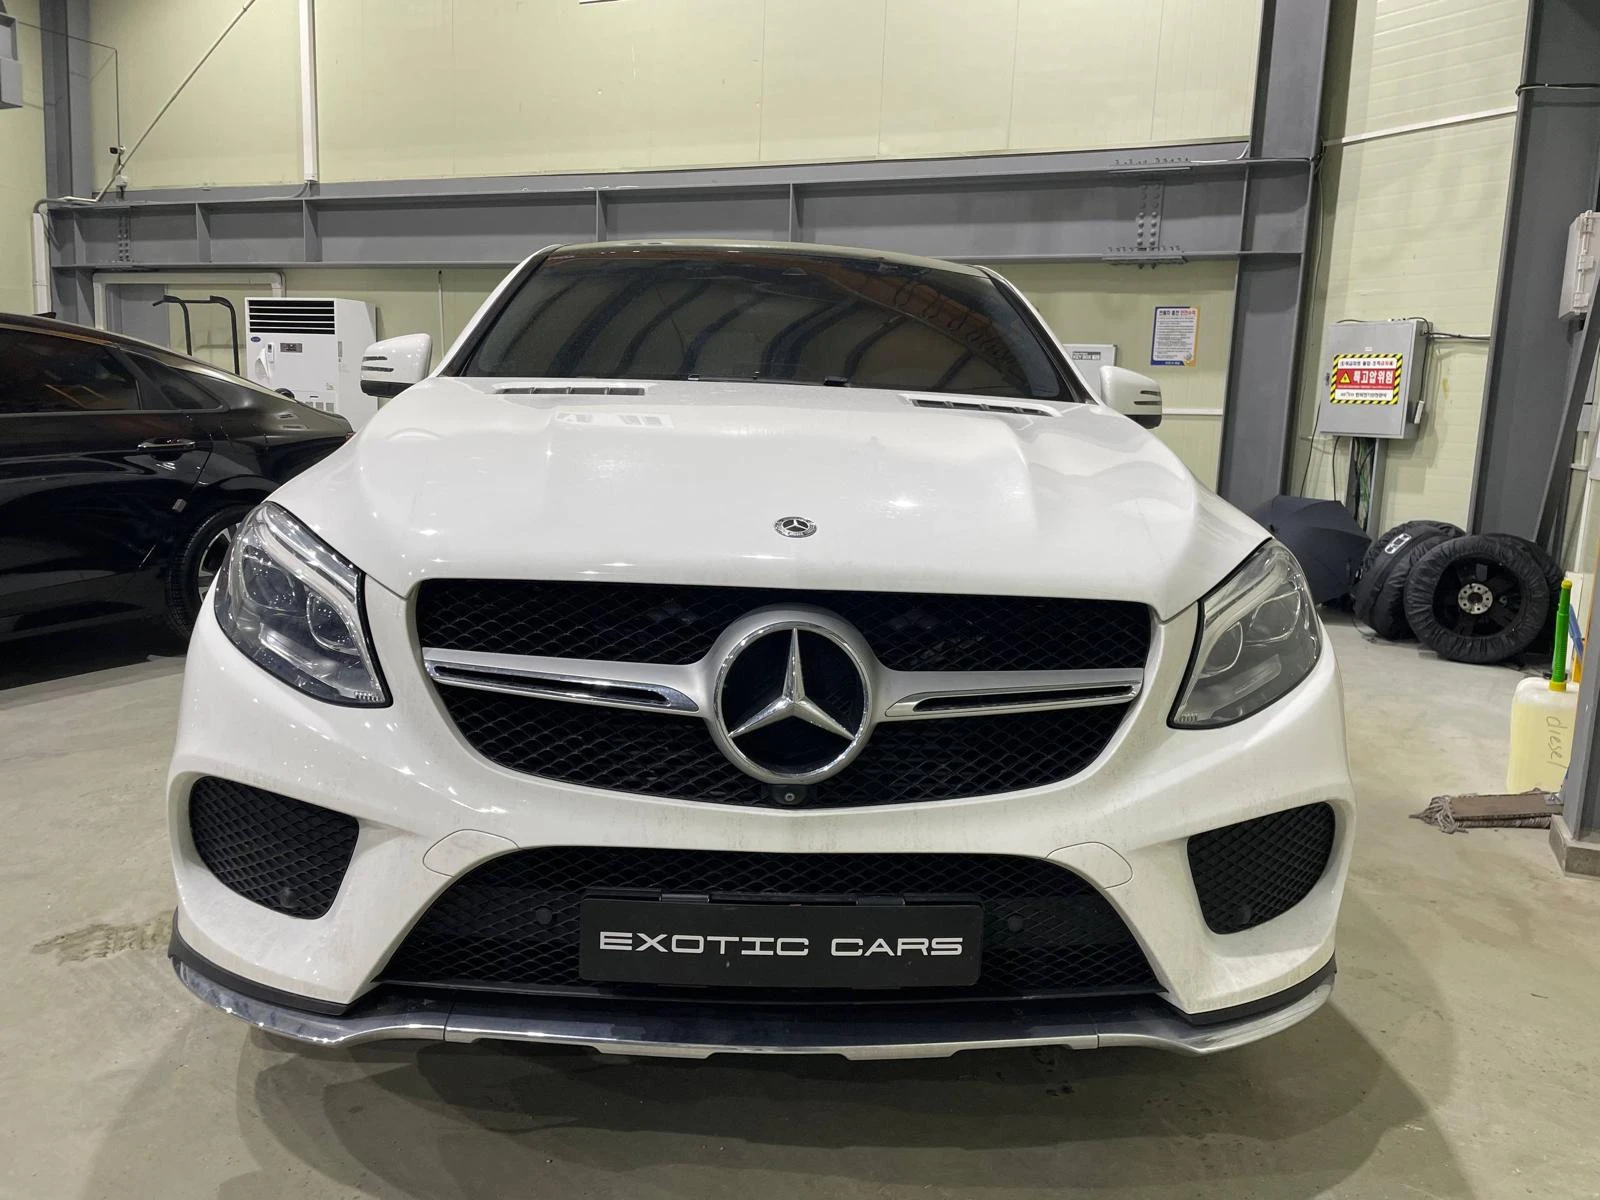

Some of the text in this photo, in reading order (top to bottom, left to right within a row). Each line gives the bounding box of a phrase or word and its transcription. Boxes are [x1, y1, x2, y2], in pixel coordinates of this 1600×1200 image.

[1546, 715, 1568, 769] diesel
[599, 931, 963, 957] EXOTIC CARS
